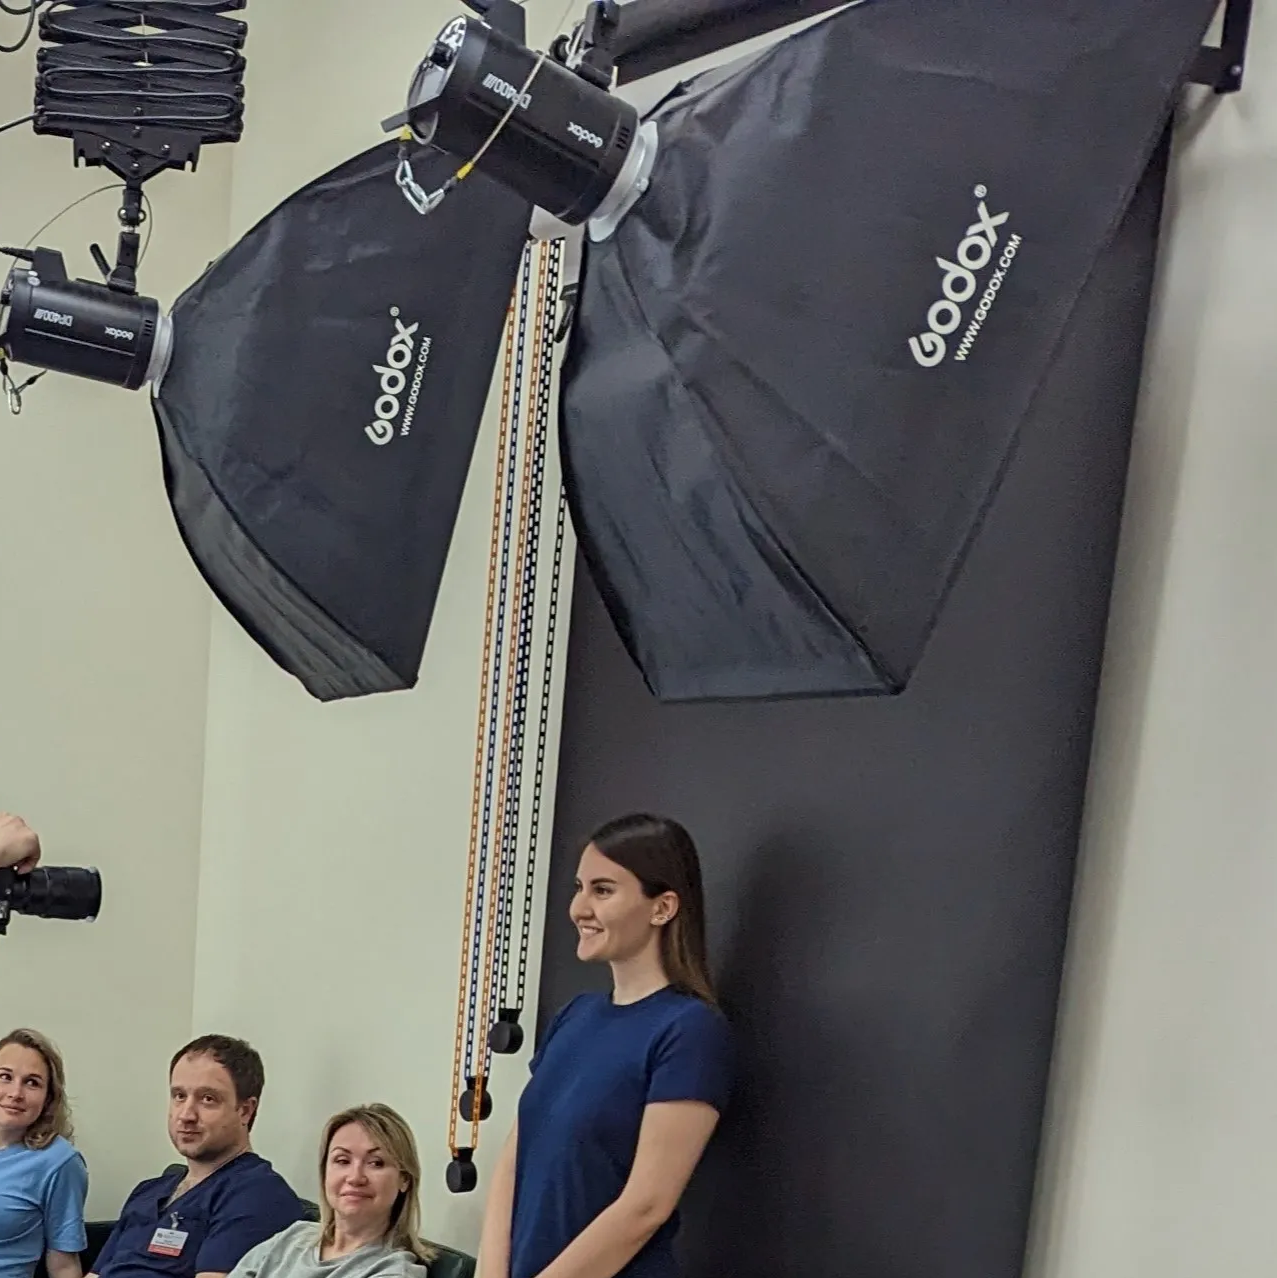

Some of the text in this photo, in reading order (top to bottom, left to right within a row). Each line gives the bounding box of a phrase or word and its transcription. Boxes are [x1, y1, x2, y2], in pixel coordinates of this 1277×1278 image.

[567, 121, 603, 148] Godox
[908, 200, 1010, 367] Godox
[954, 233, 1022, 361] WWW.GODOX.COM
[364, 318, 419, 445] Godox
[400, 336, 432, 436] WWW.GODOX.COM
